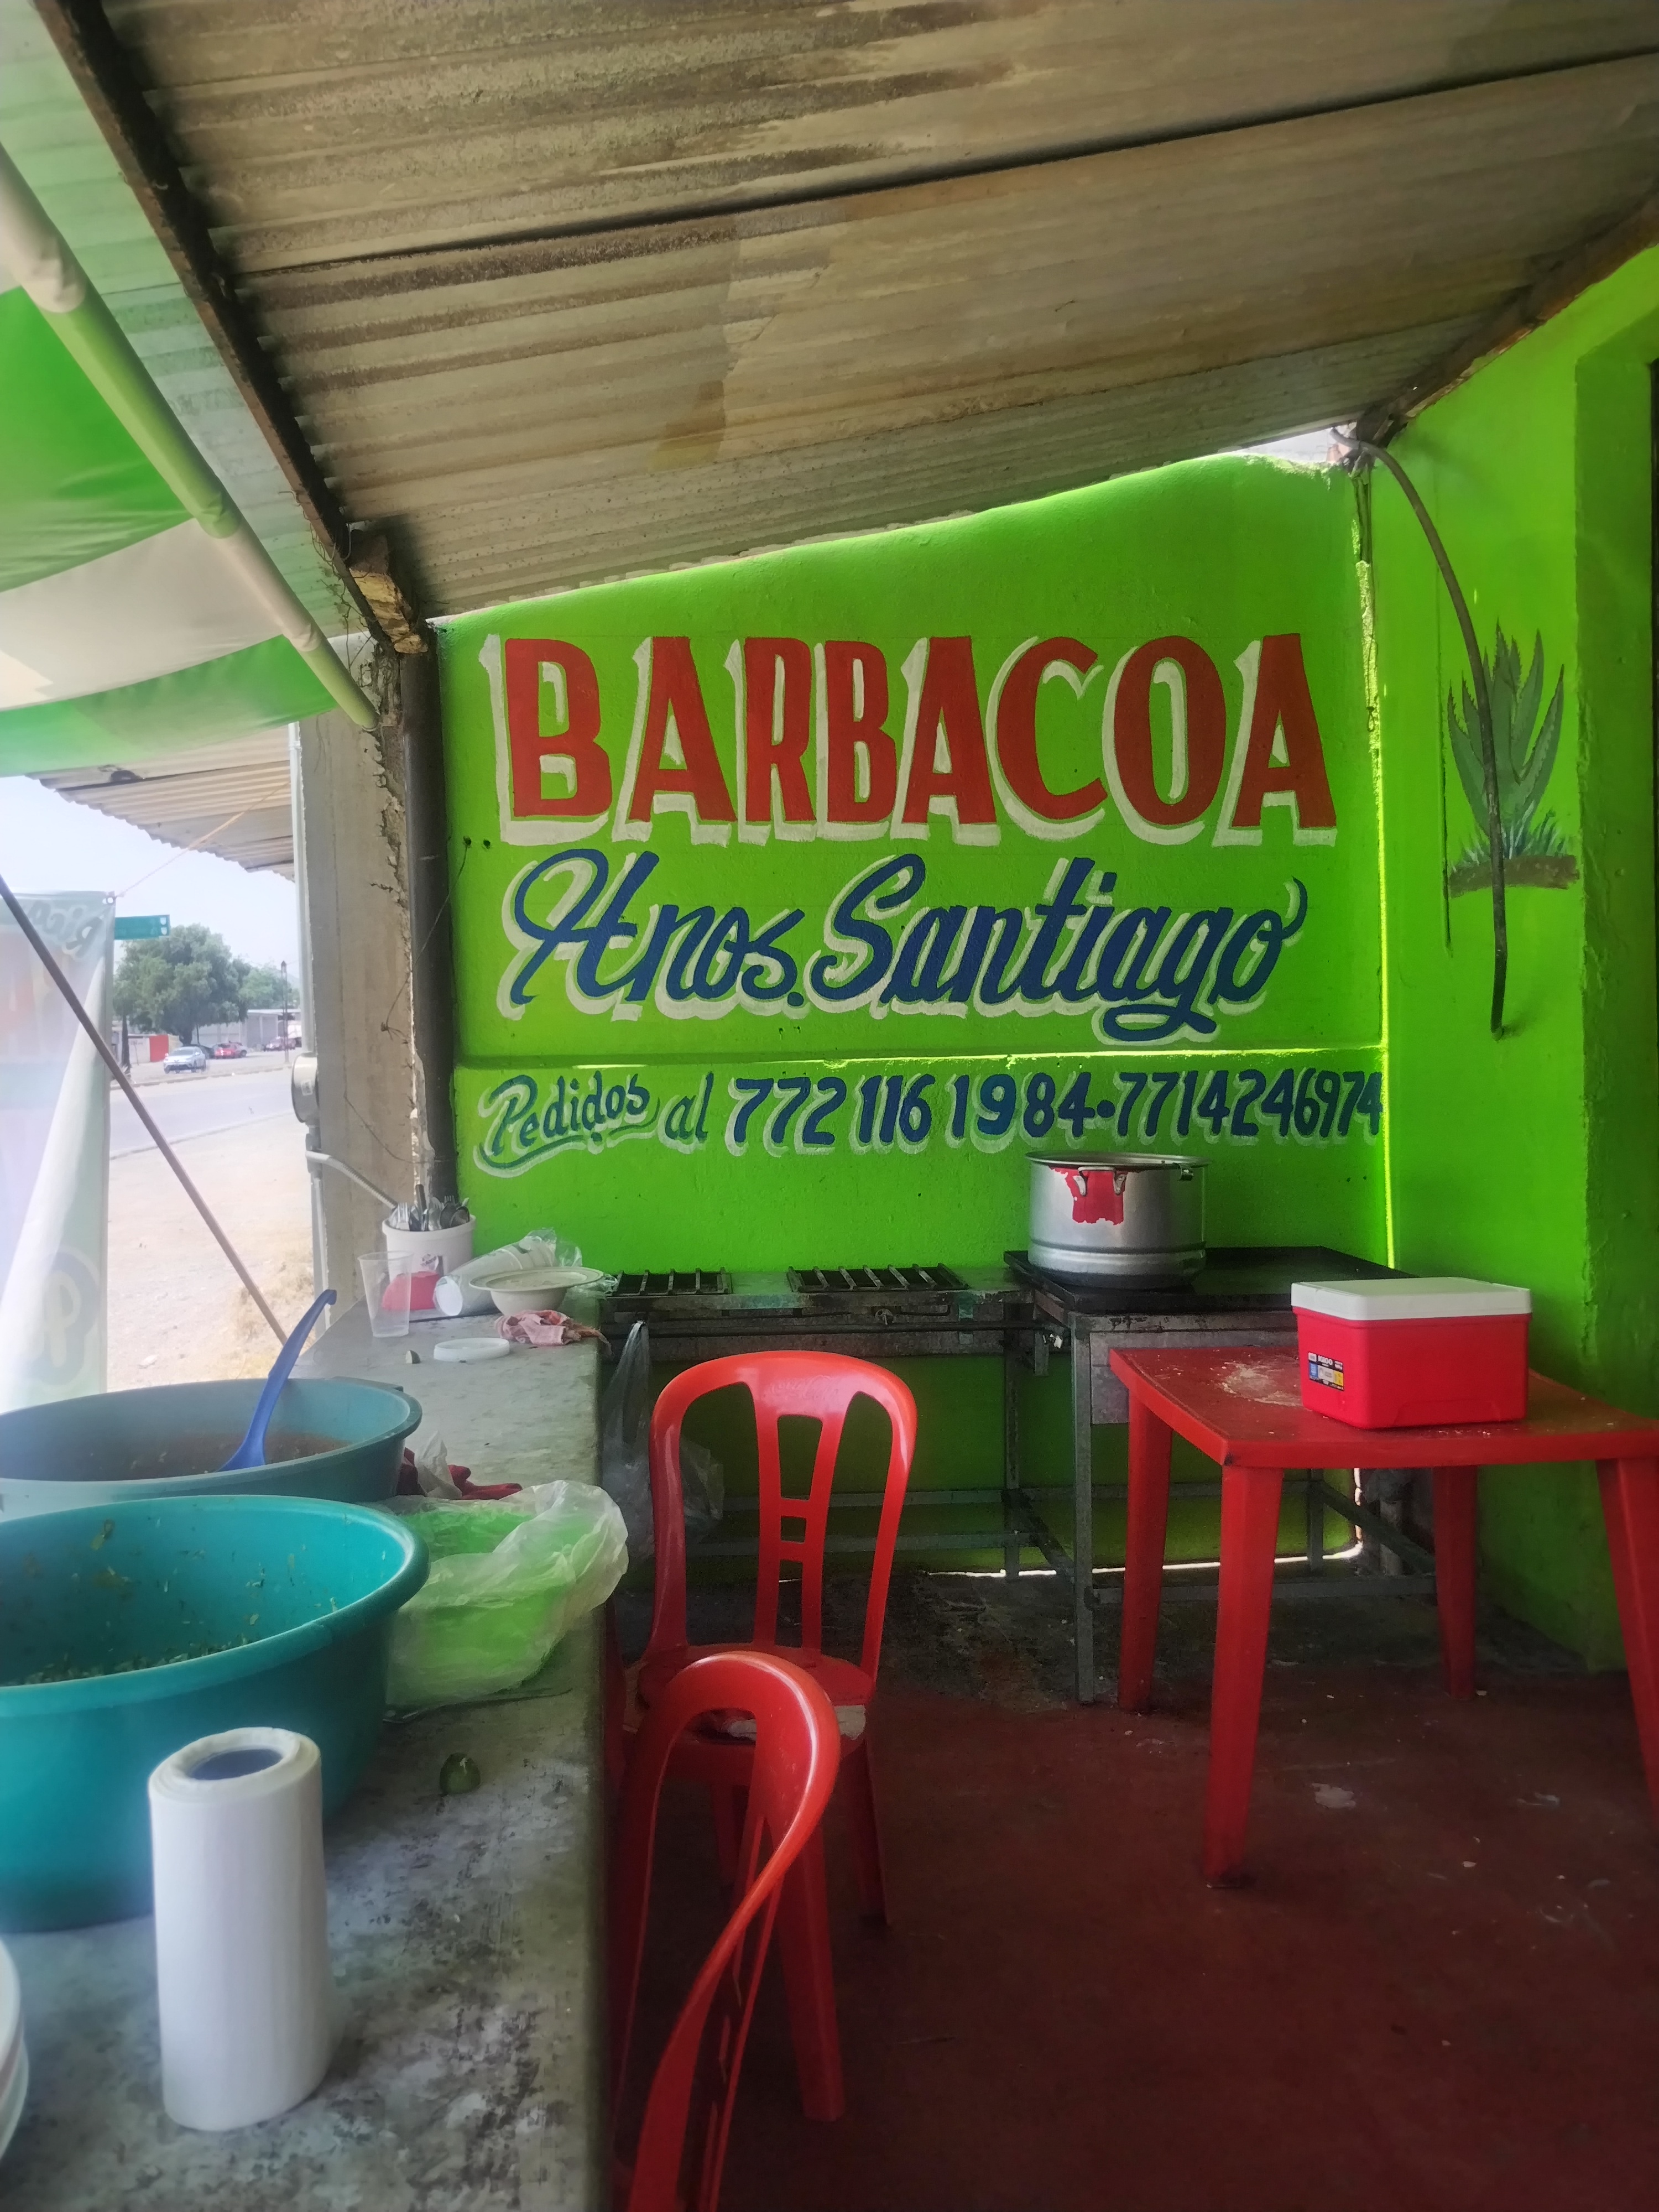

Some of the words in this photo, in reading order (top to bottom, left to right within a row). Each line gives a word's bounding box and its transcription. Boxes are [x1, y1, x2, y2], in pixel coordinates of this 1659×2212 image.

[479, 633, 1337, 846] BARBACOA
[495, 849, 809, 1020] Hnos.
[804, 852, 1308, 1046] Santiago
[475, 1071, 654, 1160] Pedidos
[658, 1071, 714, 1154] al
[726, 1076, 847, 1156] 772
[850, 1073, 936, 1154] 116
